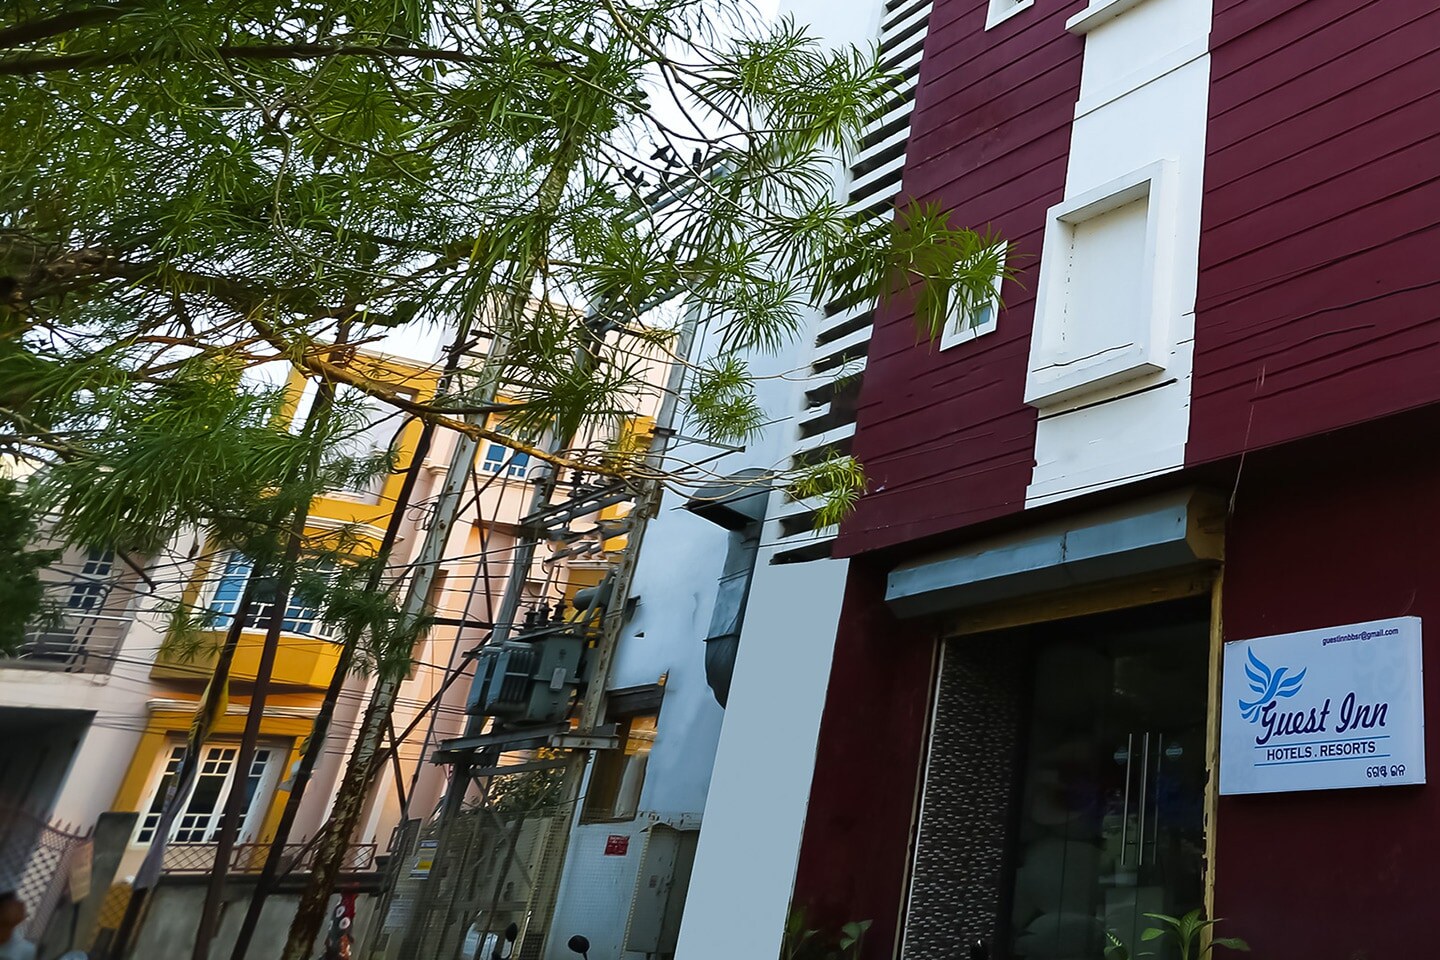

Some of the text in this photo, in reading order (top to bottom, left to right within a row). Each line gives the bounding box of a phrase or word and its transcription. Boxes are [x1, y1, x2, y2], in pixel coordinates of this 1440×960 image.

[1322, 628, 1399, 646] guestinnbbsr@gmail.com
[1256, 692, 1388, 745] Guest Inn
[1267, 746, 1312, 761] HOTELS
[1320, 741, 1376, 757] RESORTS
